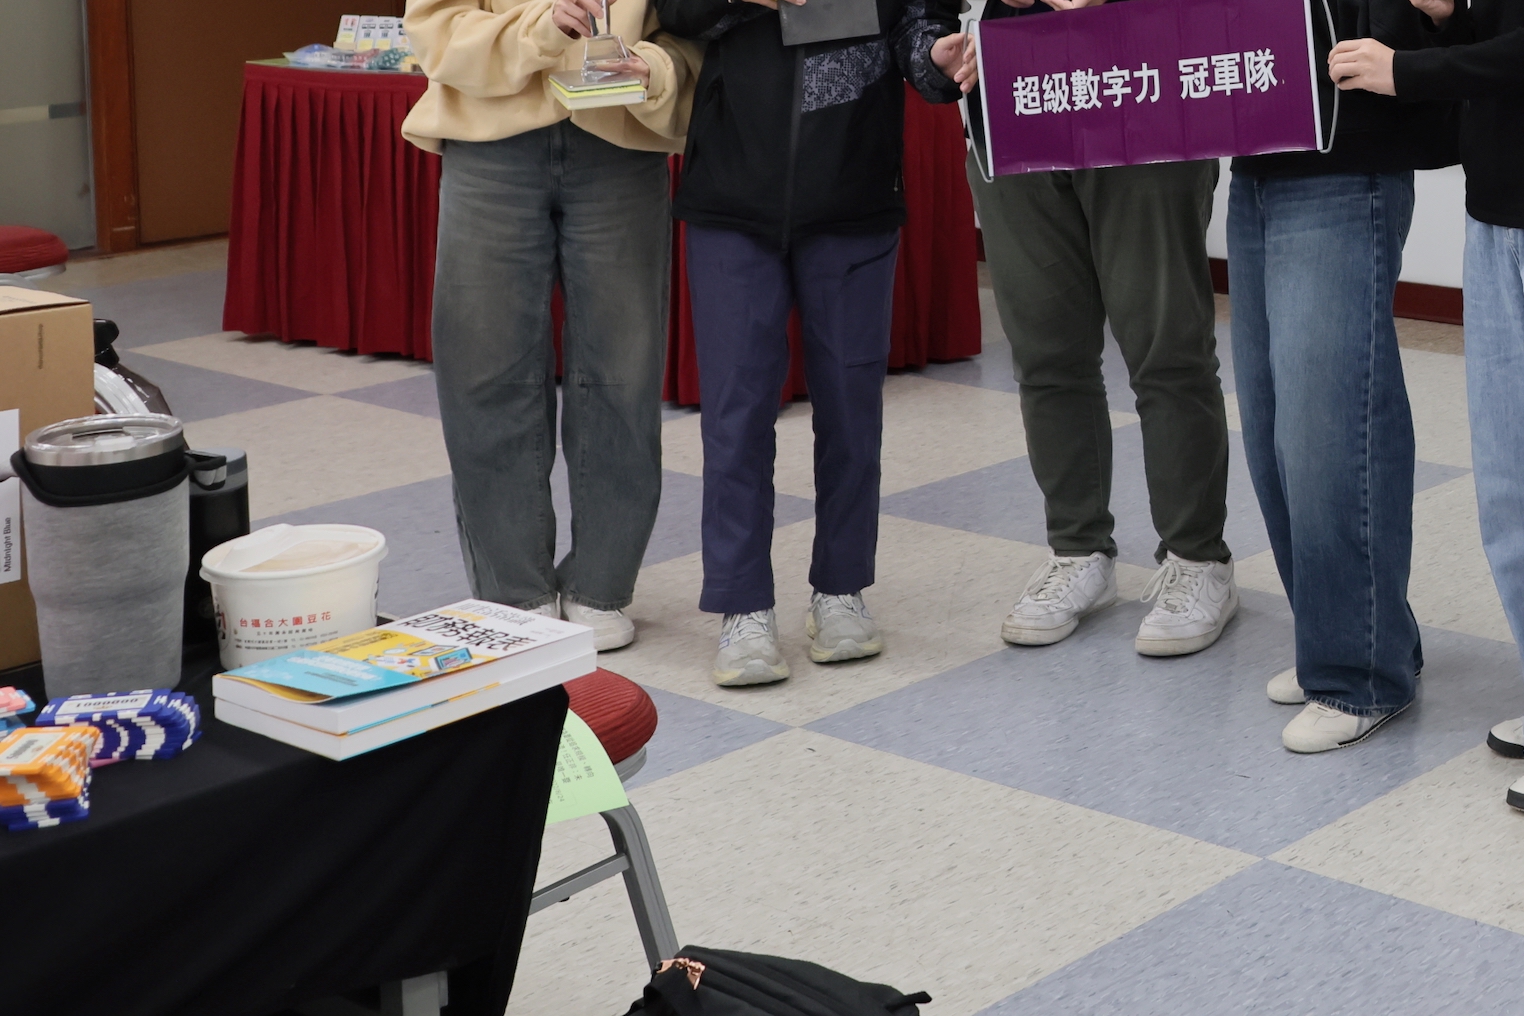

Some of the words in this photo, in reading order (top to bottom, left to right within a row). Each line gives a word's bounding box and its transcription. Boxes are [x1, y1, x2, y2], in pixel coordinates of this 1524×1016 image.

[1012, 62, 1161, 117] 超級數字力
[1179, 49, 1280, 101] 冠軍隊
[4, 516, 12, 535] Blue
[4, 535, 13, 572] Midnight
[397, 613, 538, 651] 財務報表
